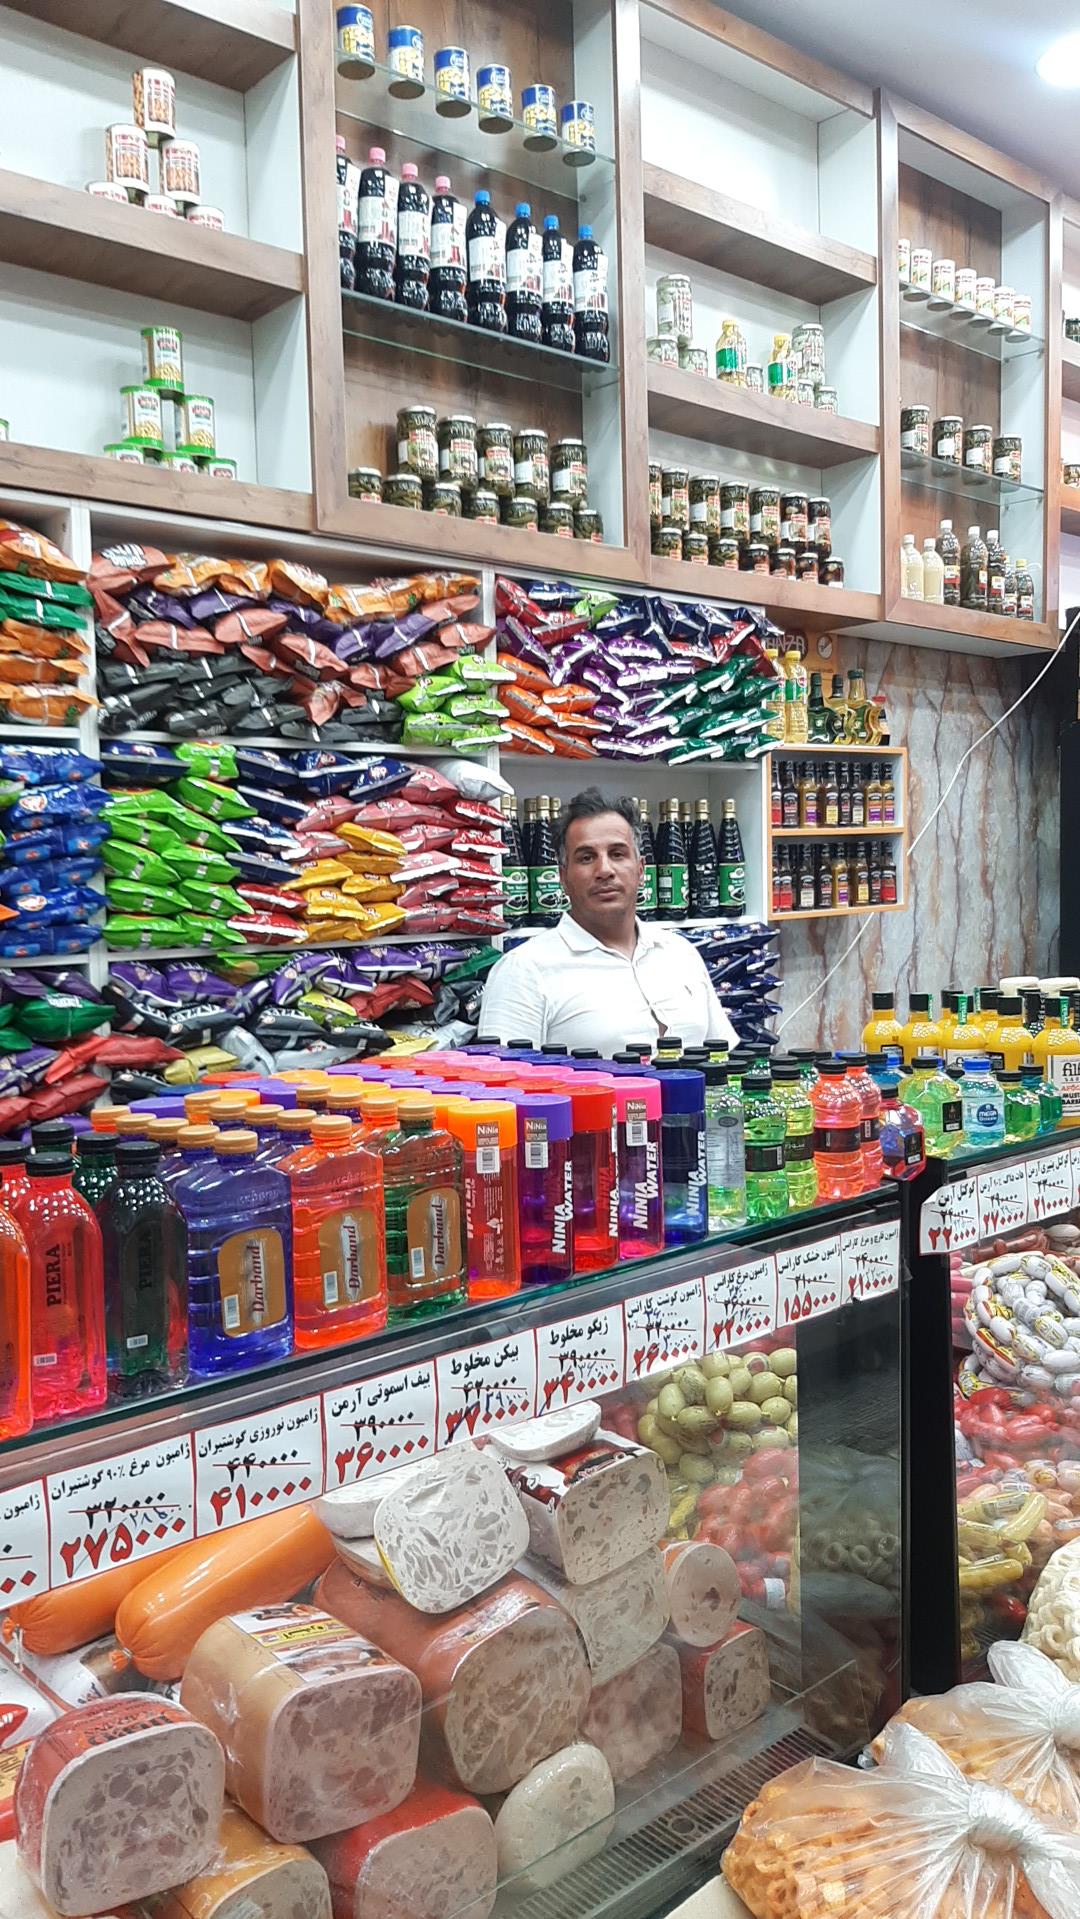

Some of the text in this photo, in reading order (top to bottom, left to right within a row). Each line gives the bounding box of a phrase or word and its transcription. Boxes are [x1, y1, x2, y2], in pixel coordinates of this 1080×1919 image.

[563, 1160, 574, 1222] WATER
[646, 1141, 659, 1199] WATER
[343, 1224, 361, 1290] Darband
[431, 1202, 446, 1266] Darband
[46, 1243, 63, 1308] PIERA
[246, 1244, 266, 1314] Darband
[783, 1290, 837, 1323] ۱۵۵۰۰۰
[450, 1342, 519, 1379] بیکن مخلوط
[549, 1322, 584, 1349] مخلوط
[331, 1371, 431, 1418] بیف اسموتی آرمن
[198, 1407, 319, 1458] ژامبون نوروزی گوشتیران
[445, 1398, 530, 1443] ۳۷۰۰۰۰
[129, 1457, 151, 1477] مرغ
[155, 1443, 192, 1468] ژامبون
[334, 1434, 430, 1486] ۳۶۰۰۰۰
[3, 1493, 41, 1520] ژامبون
[50, 1469, 104, 1500] گوشتیران
[209, 1476, 313, 1527] ۴۱۰۰۰۰
[59, 1517, 187, 1579] ۲۷۵۰۰۰
